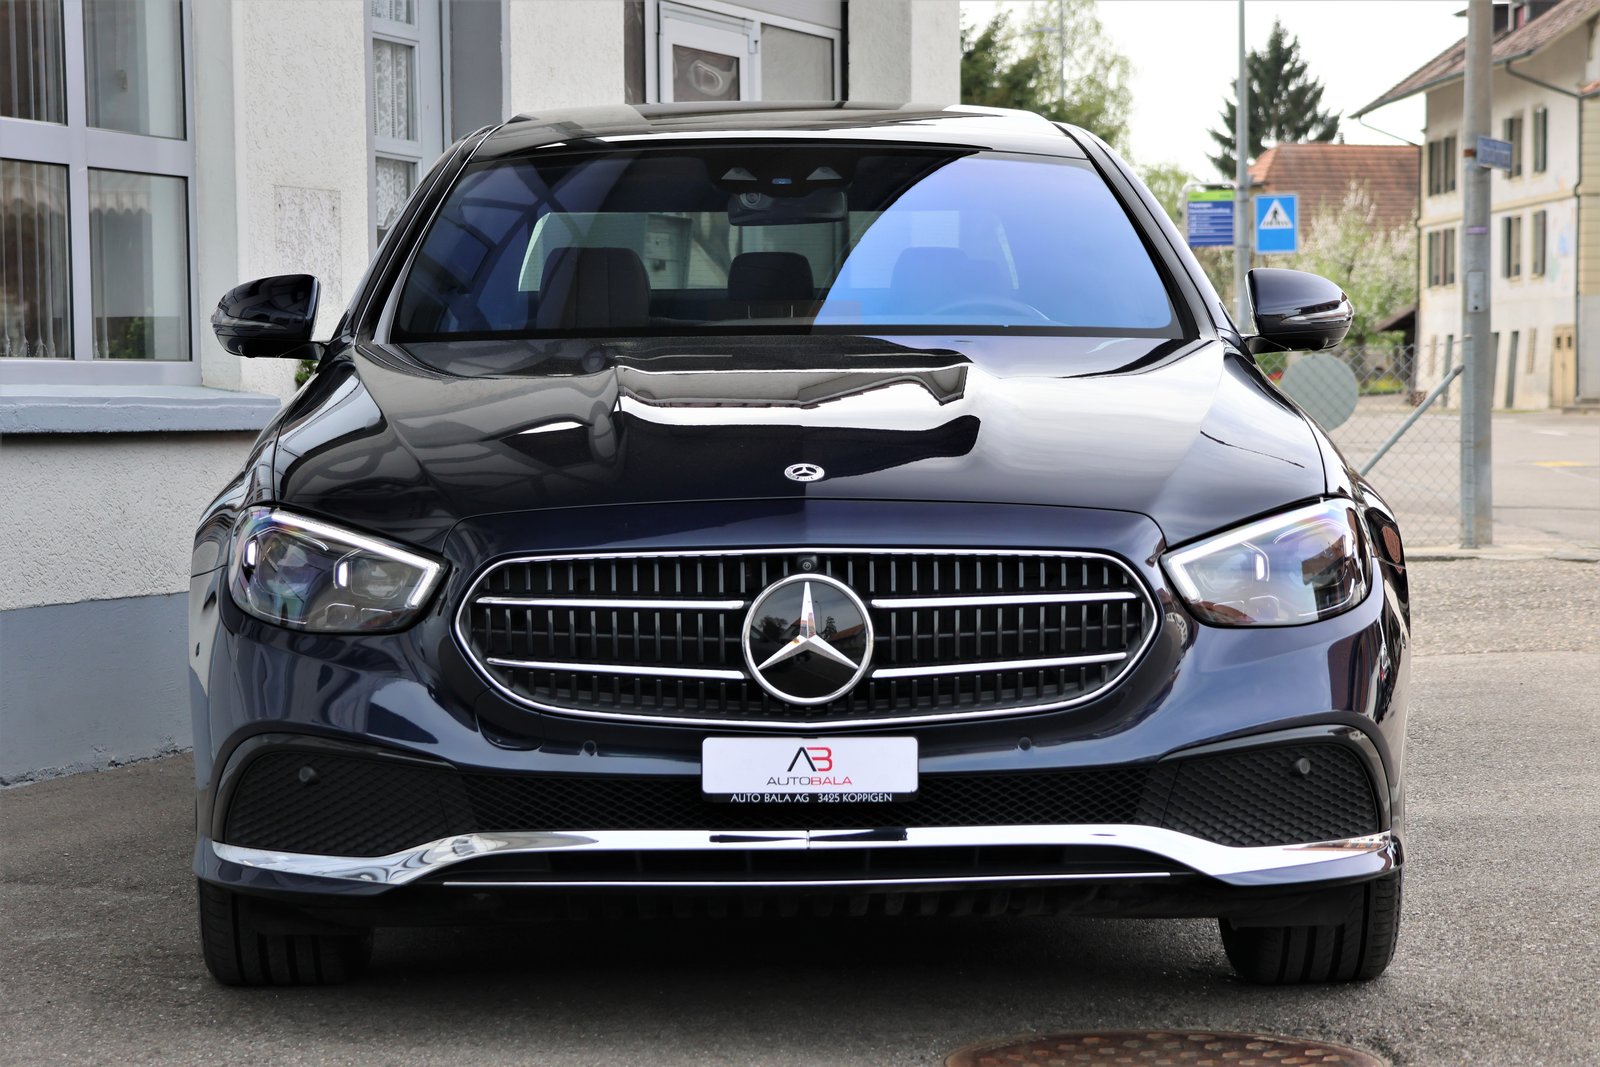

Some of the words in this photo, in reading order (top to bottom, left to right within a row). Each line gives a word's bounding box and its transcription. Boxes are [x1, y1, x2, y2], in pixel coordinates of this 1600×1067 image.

[766, 776, 852, 786] AUTOBALA
[730, 793, 761, 803] AUTO
[764, 793, 792, 803] BALA
[794, 793, 810, 803] AG
[817, 793, 840, 803] 3425
[843, 793, 892, 803] KOPPIGEN
